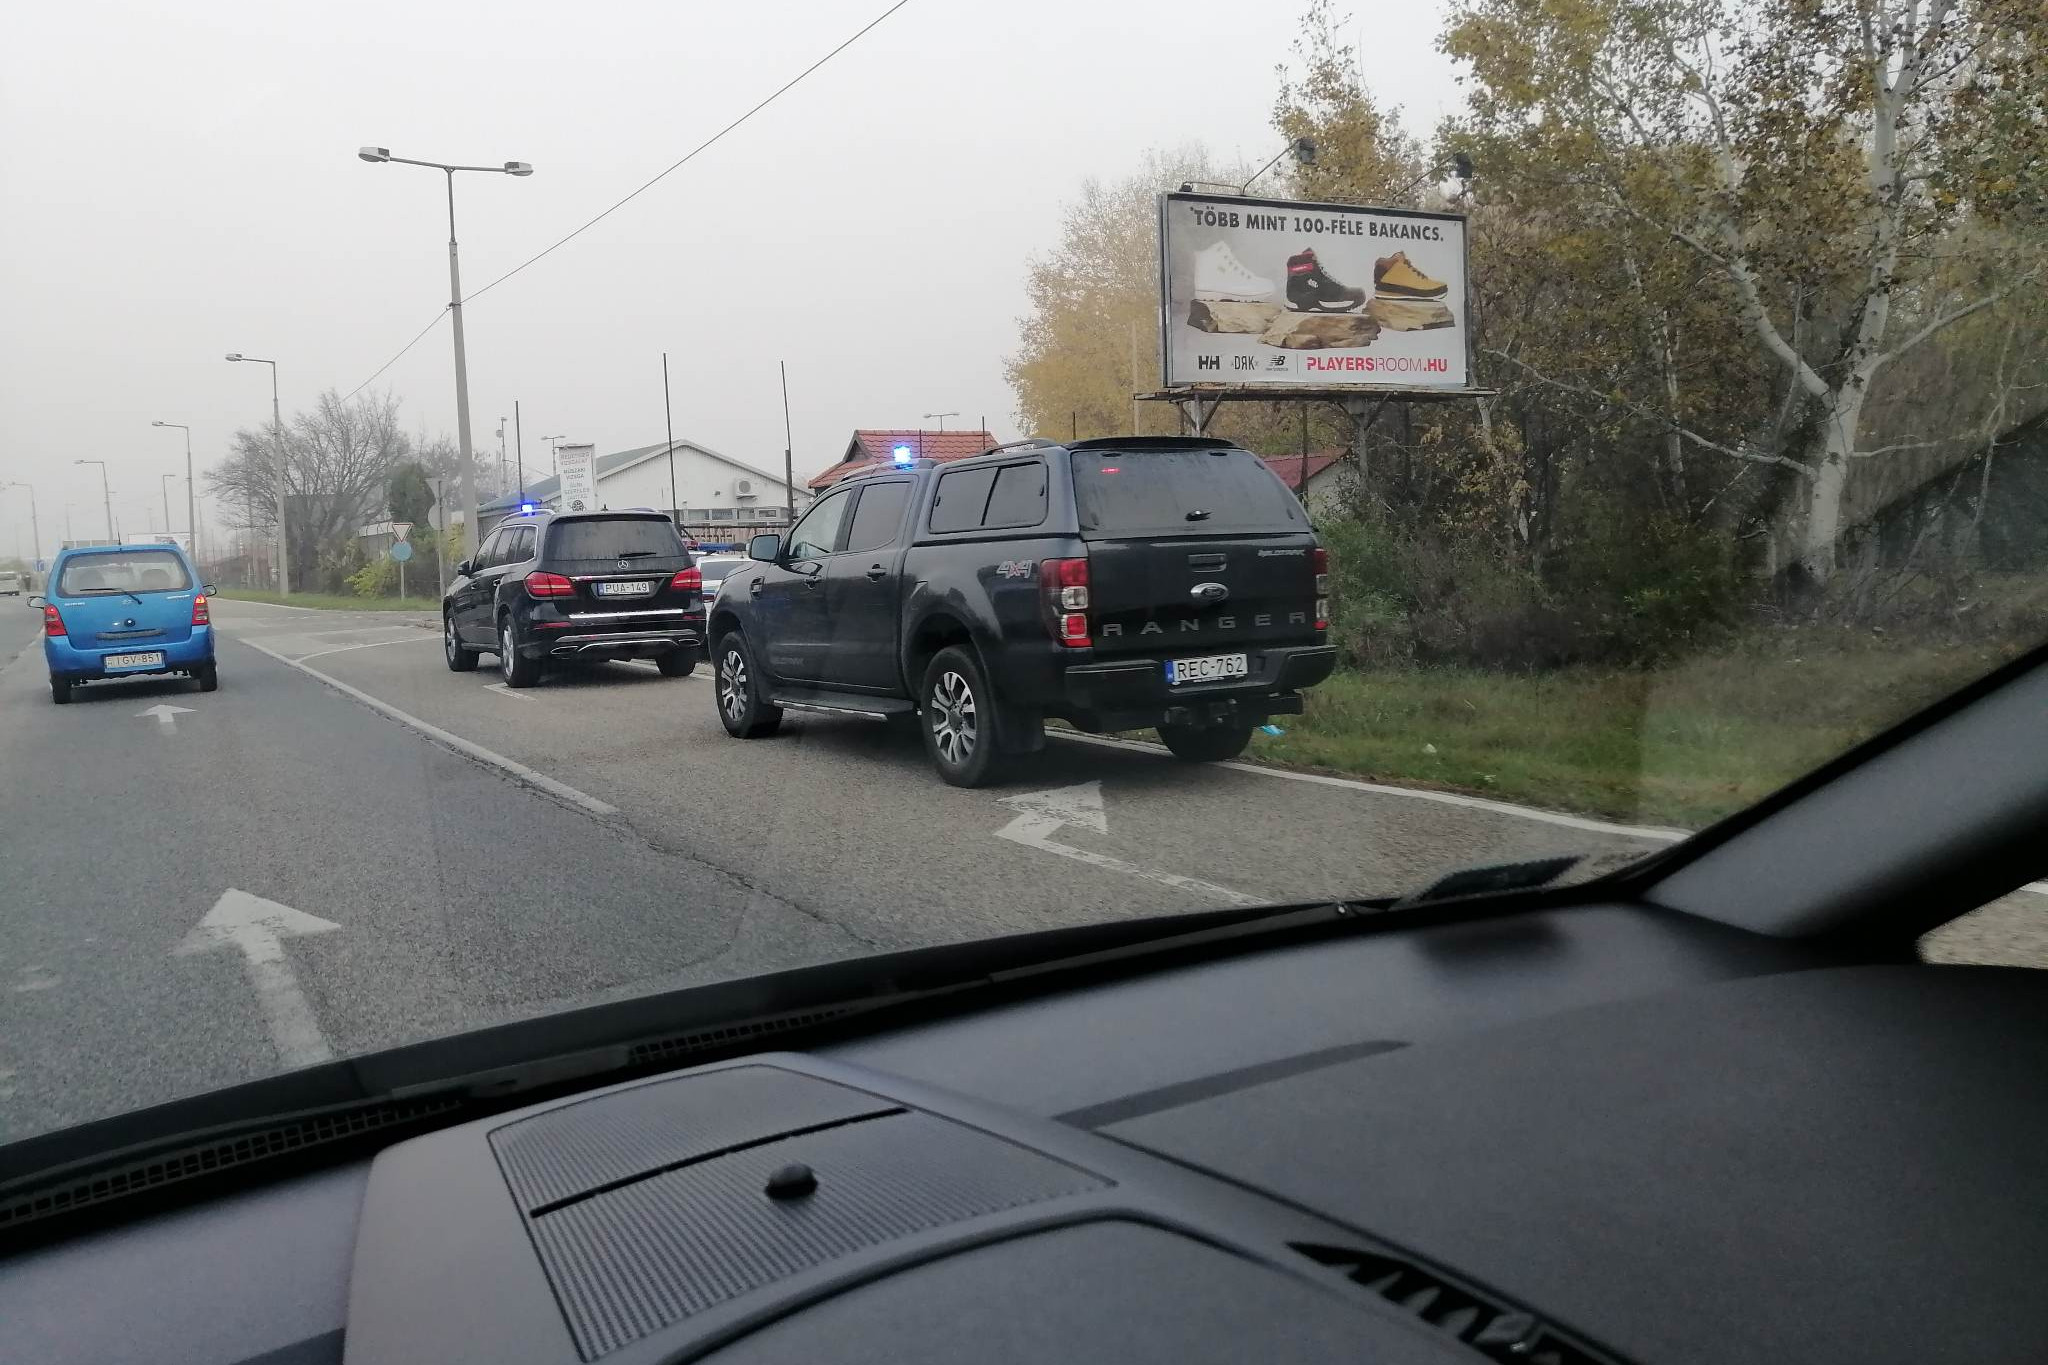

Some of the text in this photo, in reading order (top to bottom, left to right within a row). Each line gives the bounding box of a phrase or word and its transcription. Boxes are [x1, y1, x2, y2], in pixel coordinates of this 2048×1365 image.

[1194, 205, 1444, 242] TÖBB MINT 100-FÉLE BAKANCS.
[1198, 355, 1220, 370] HH
[605, 582, 648, 593] PUA-149
[1103, 612, 1305, 637] RANGER
[116, 653, 160, 666] IGV-851
[1177, 656, 1244, 679] REC-762
